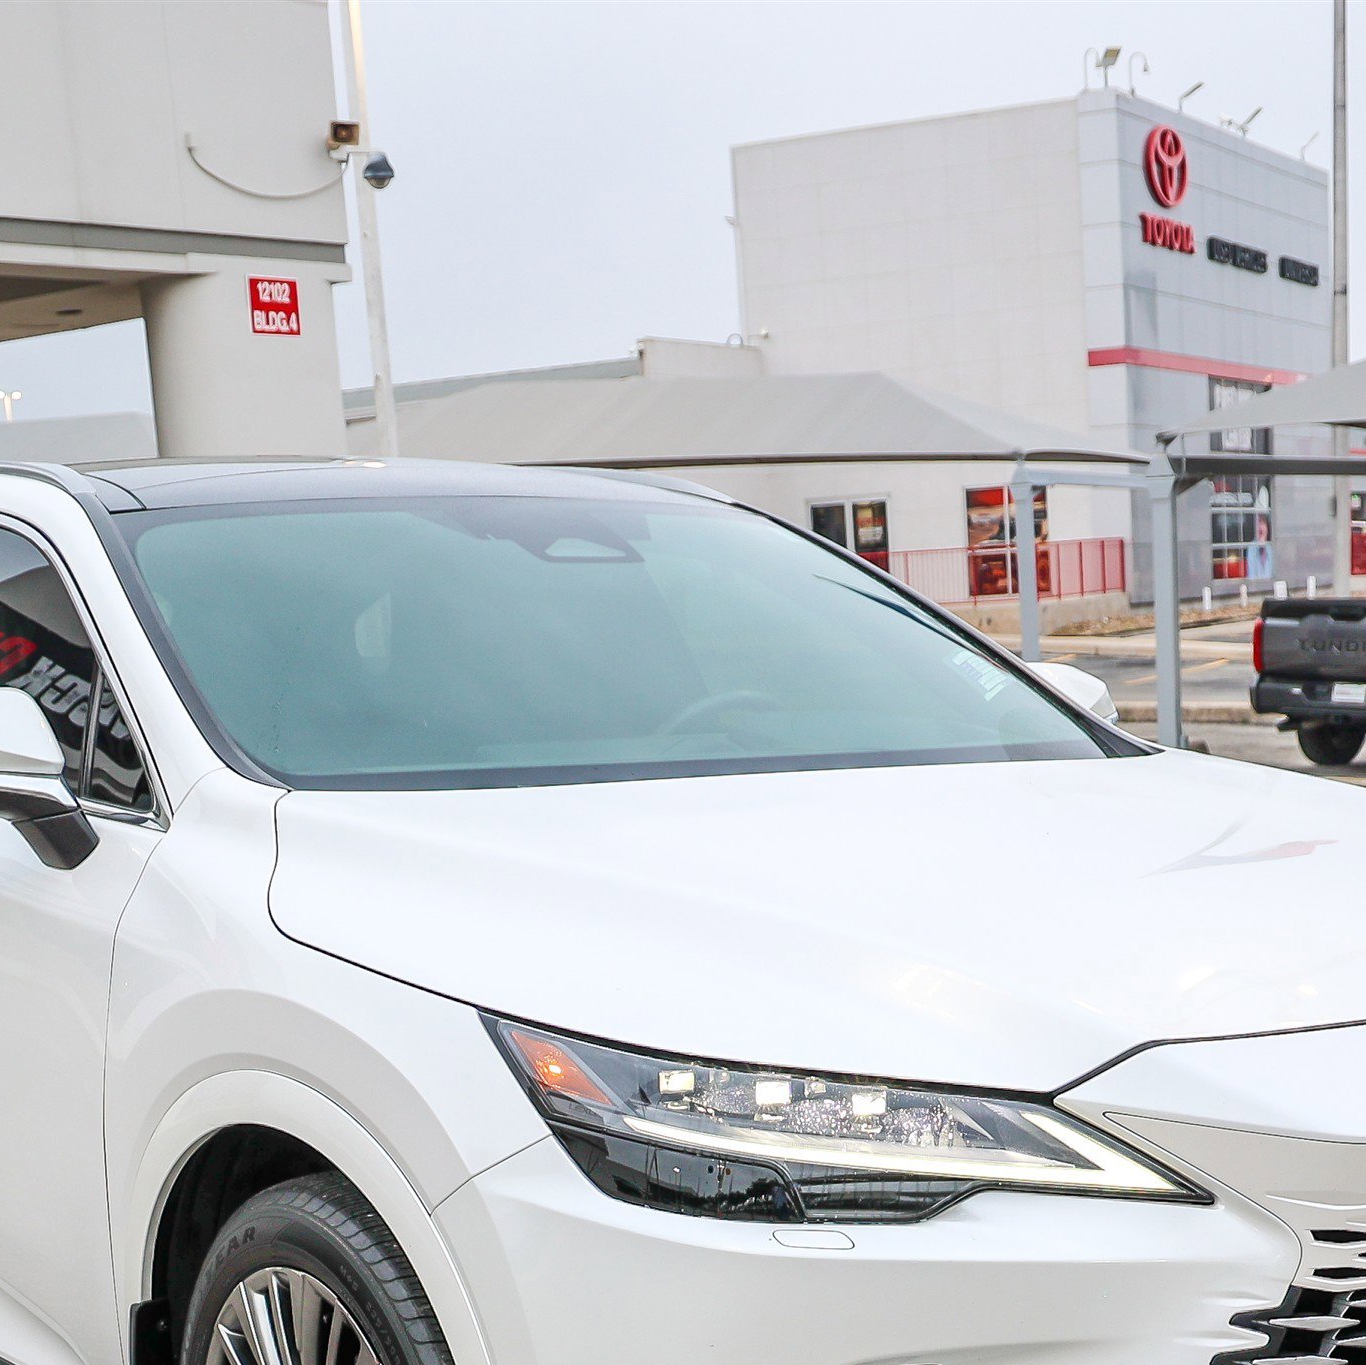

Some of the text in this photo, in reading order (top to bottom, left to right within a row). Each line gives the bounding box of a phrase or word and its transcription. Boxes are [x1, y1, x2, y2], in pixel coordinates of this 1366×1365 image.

[1138, 212, 1196, 254] TOYOTA
[256, 281, 291, 303] 12102
[289, 311, 298, 332] 4
